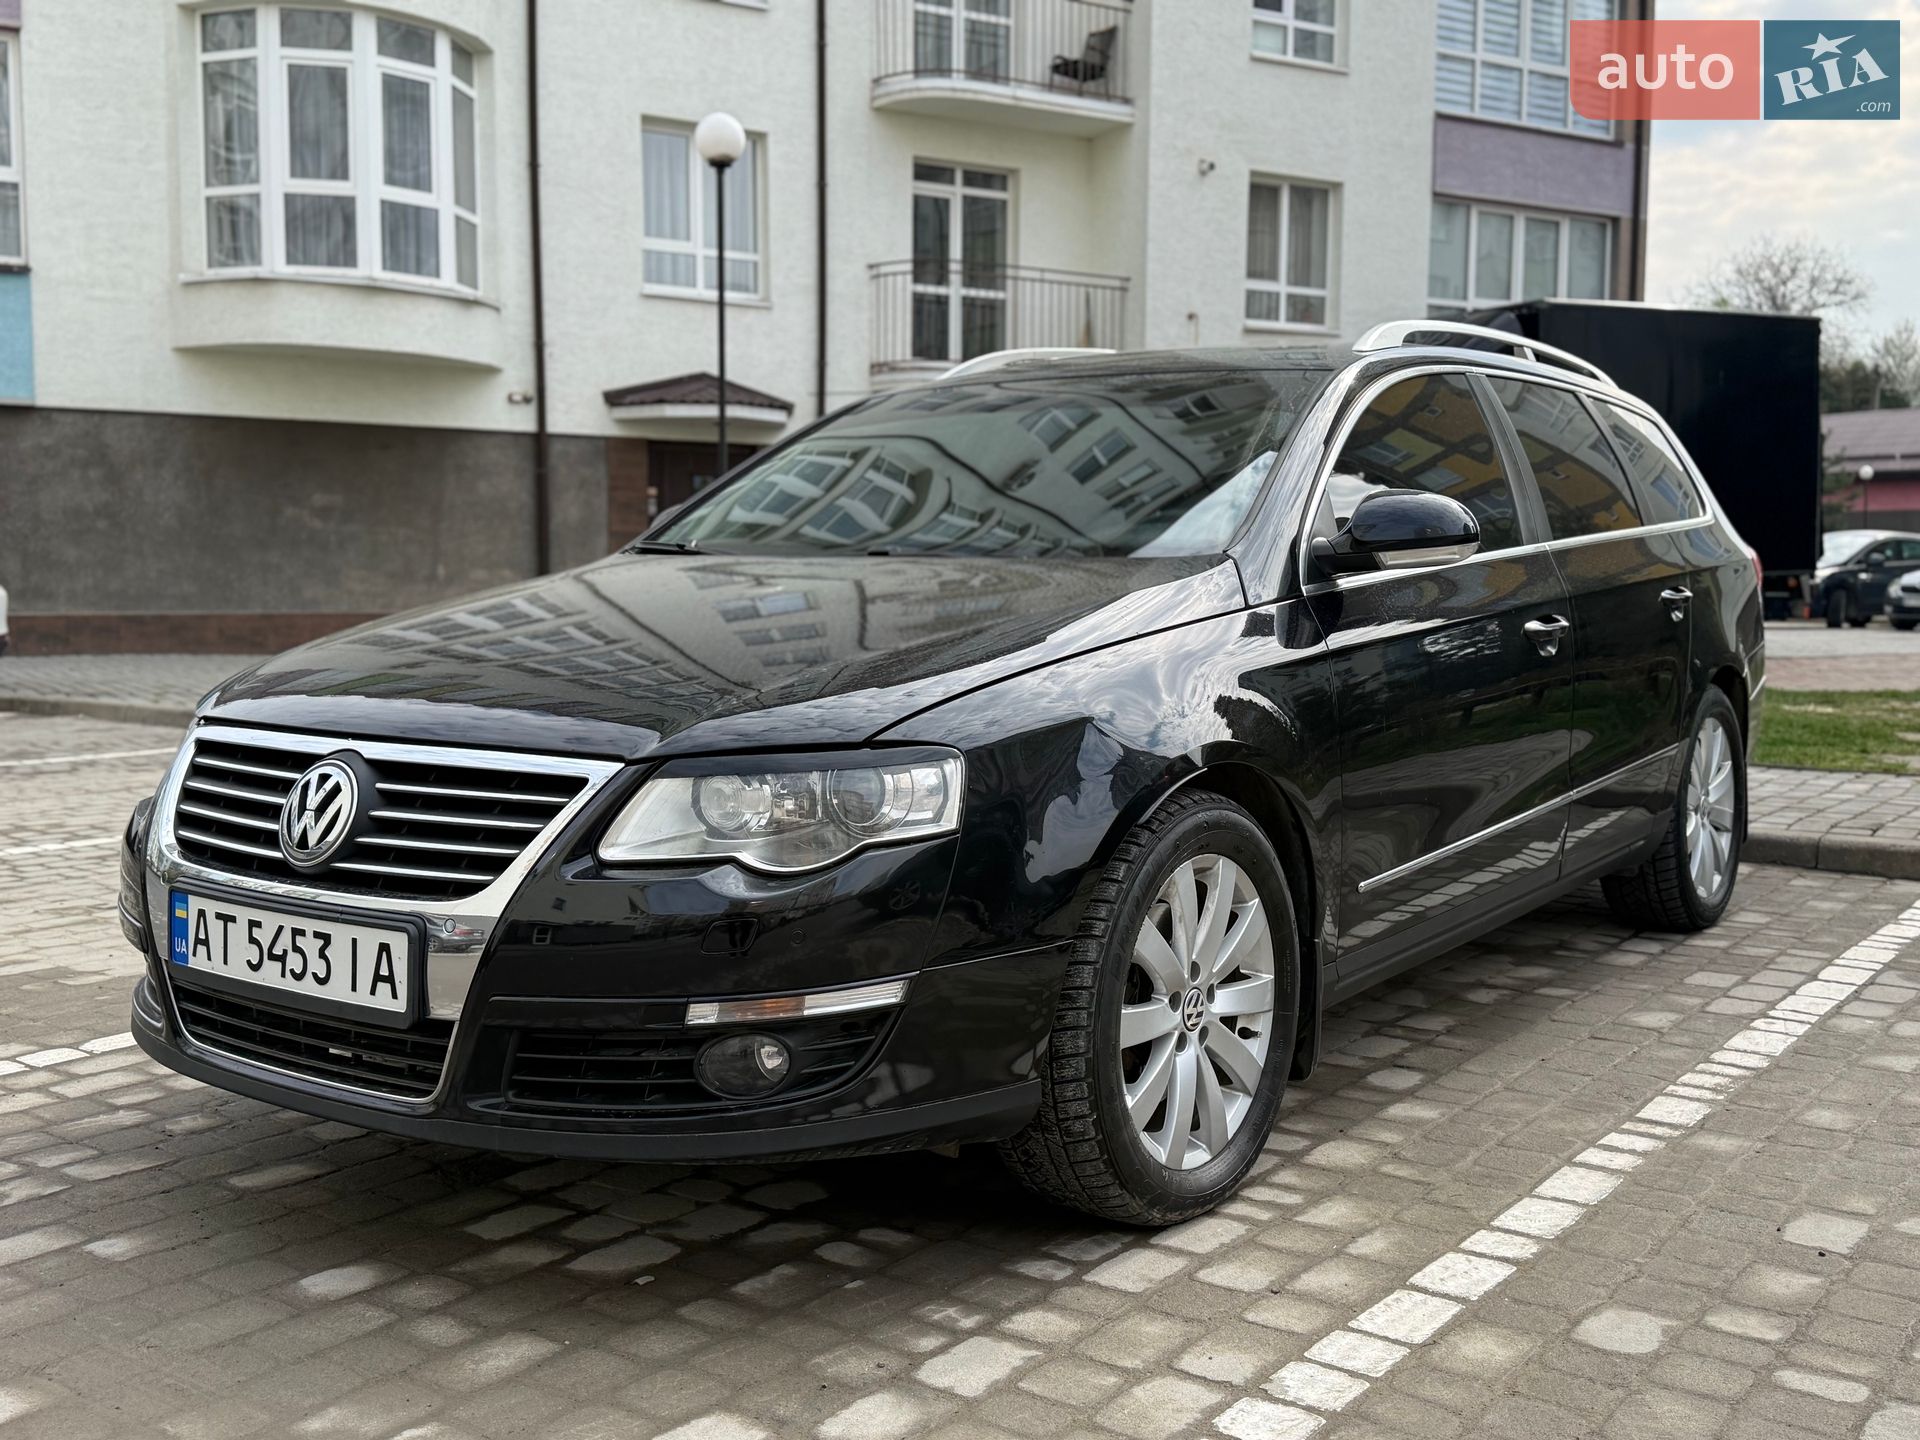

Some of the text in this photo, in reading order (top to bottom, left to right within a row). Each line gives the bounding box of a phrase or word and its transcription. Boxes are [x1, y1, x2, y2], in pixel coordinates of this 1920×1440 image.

[282, 765, 353, 860] VW
[174, 937, 188, 955] UA
[191, 907, 399, 1000] AT 5453 IA
